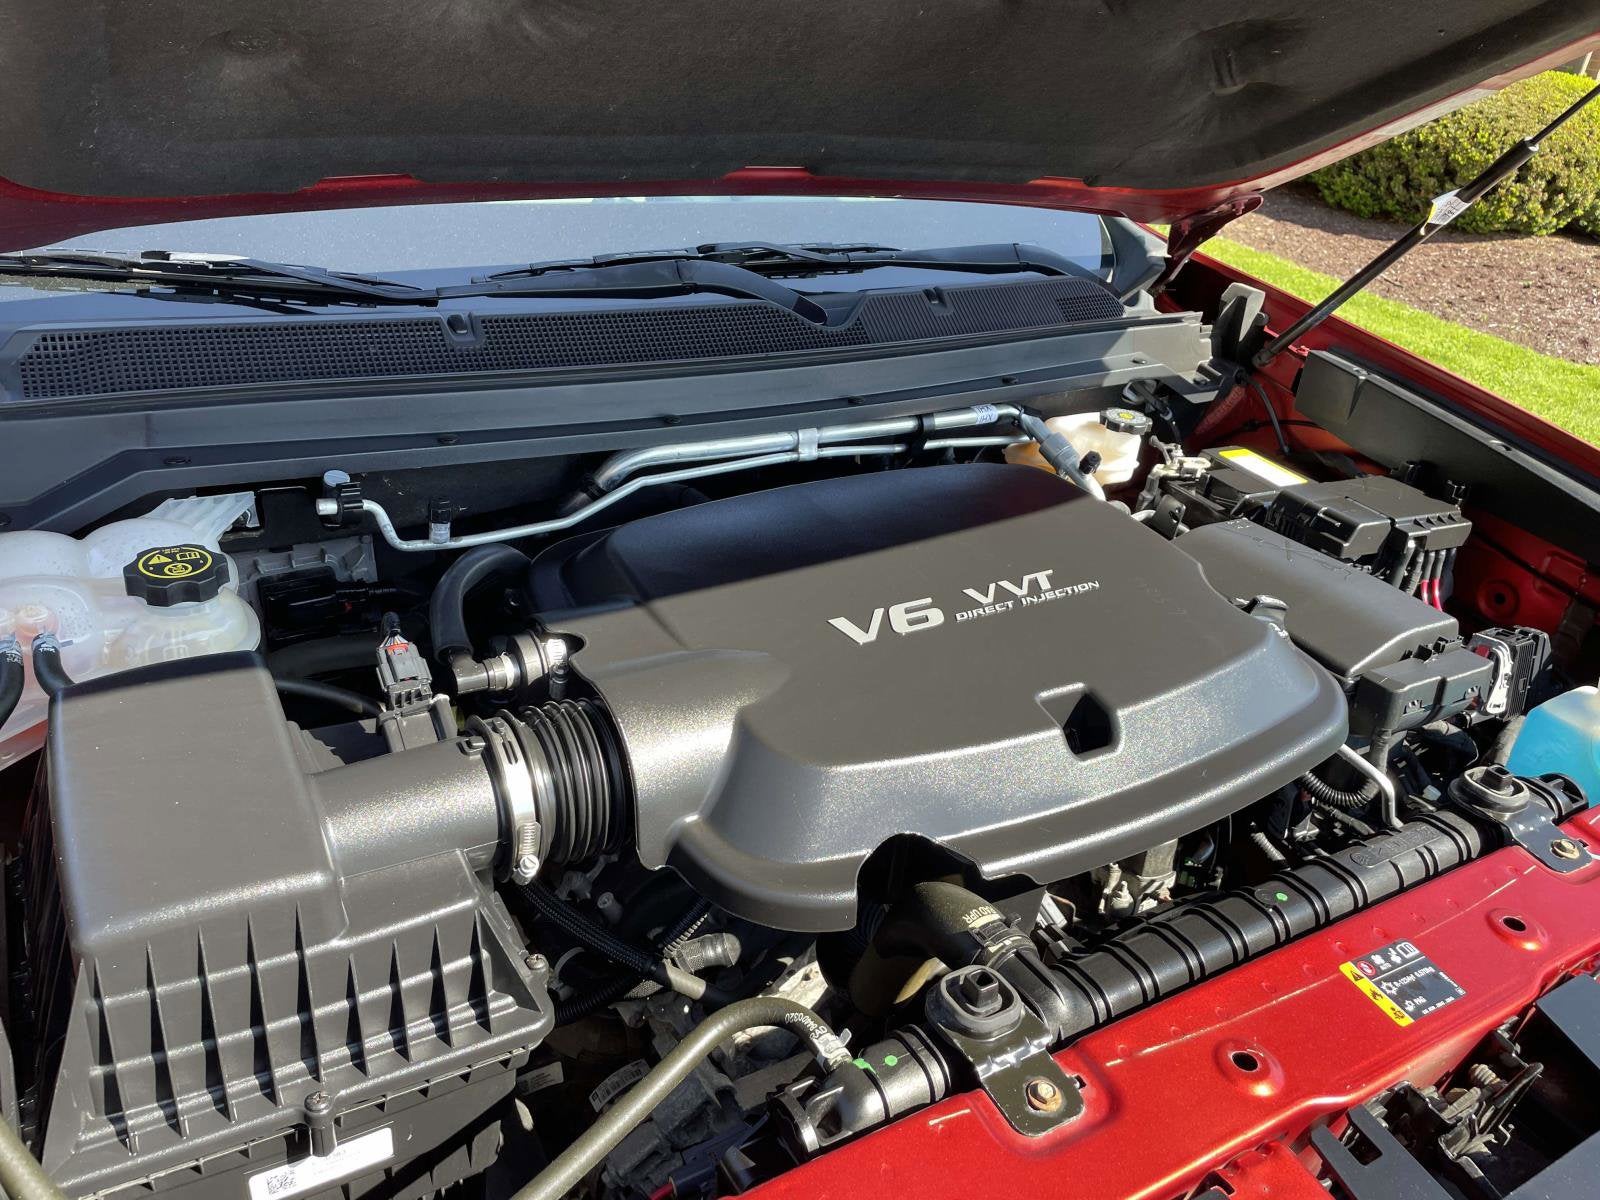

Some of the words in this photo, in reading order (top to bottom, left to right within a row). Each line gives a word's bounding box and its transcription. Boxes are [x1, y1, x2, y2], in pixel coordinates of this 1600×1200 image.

[962, 569, 1053, 606] VVT
[955, 600, 1014, 623] DIRECT
[1021, 581, 1101, 608] INJECTION
[827, 597, 944, 645] V6
[962, 908, 981, 924] UPR
[978, 905, 997, 917] RAD
[809, 1025, 828, 1041] RAD
